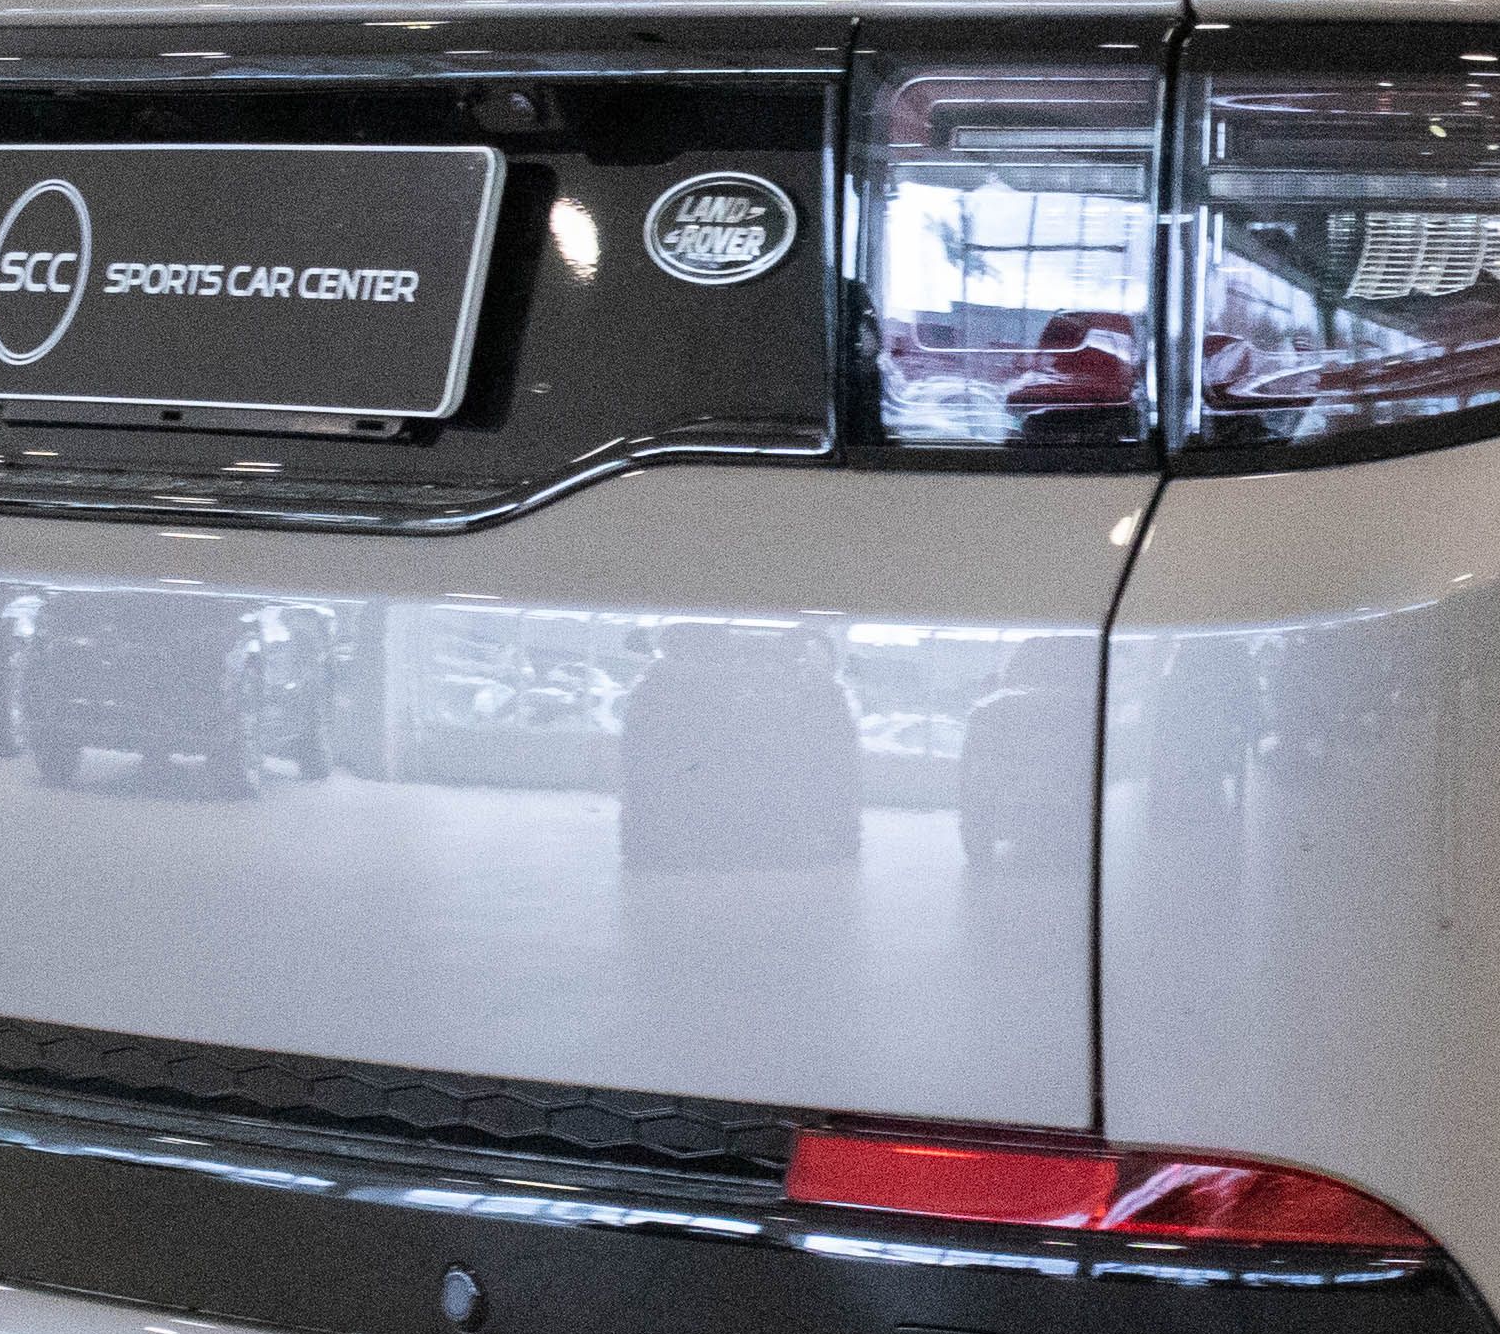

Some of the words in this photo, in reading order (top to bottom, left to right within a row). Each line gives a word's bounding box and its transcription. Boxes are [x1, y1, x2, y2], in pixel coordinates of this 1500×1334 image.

[675, 196, 752, 223] LAND
[674, 225, 767, 256] ROVER
[103, 263, 225, 296] SPORTS
[226, 266, 296, 298] CAR
[299, 267, 420, 303] CENTER
